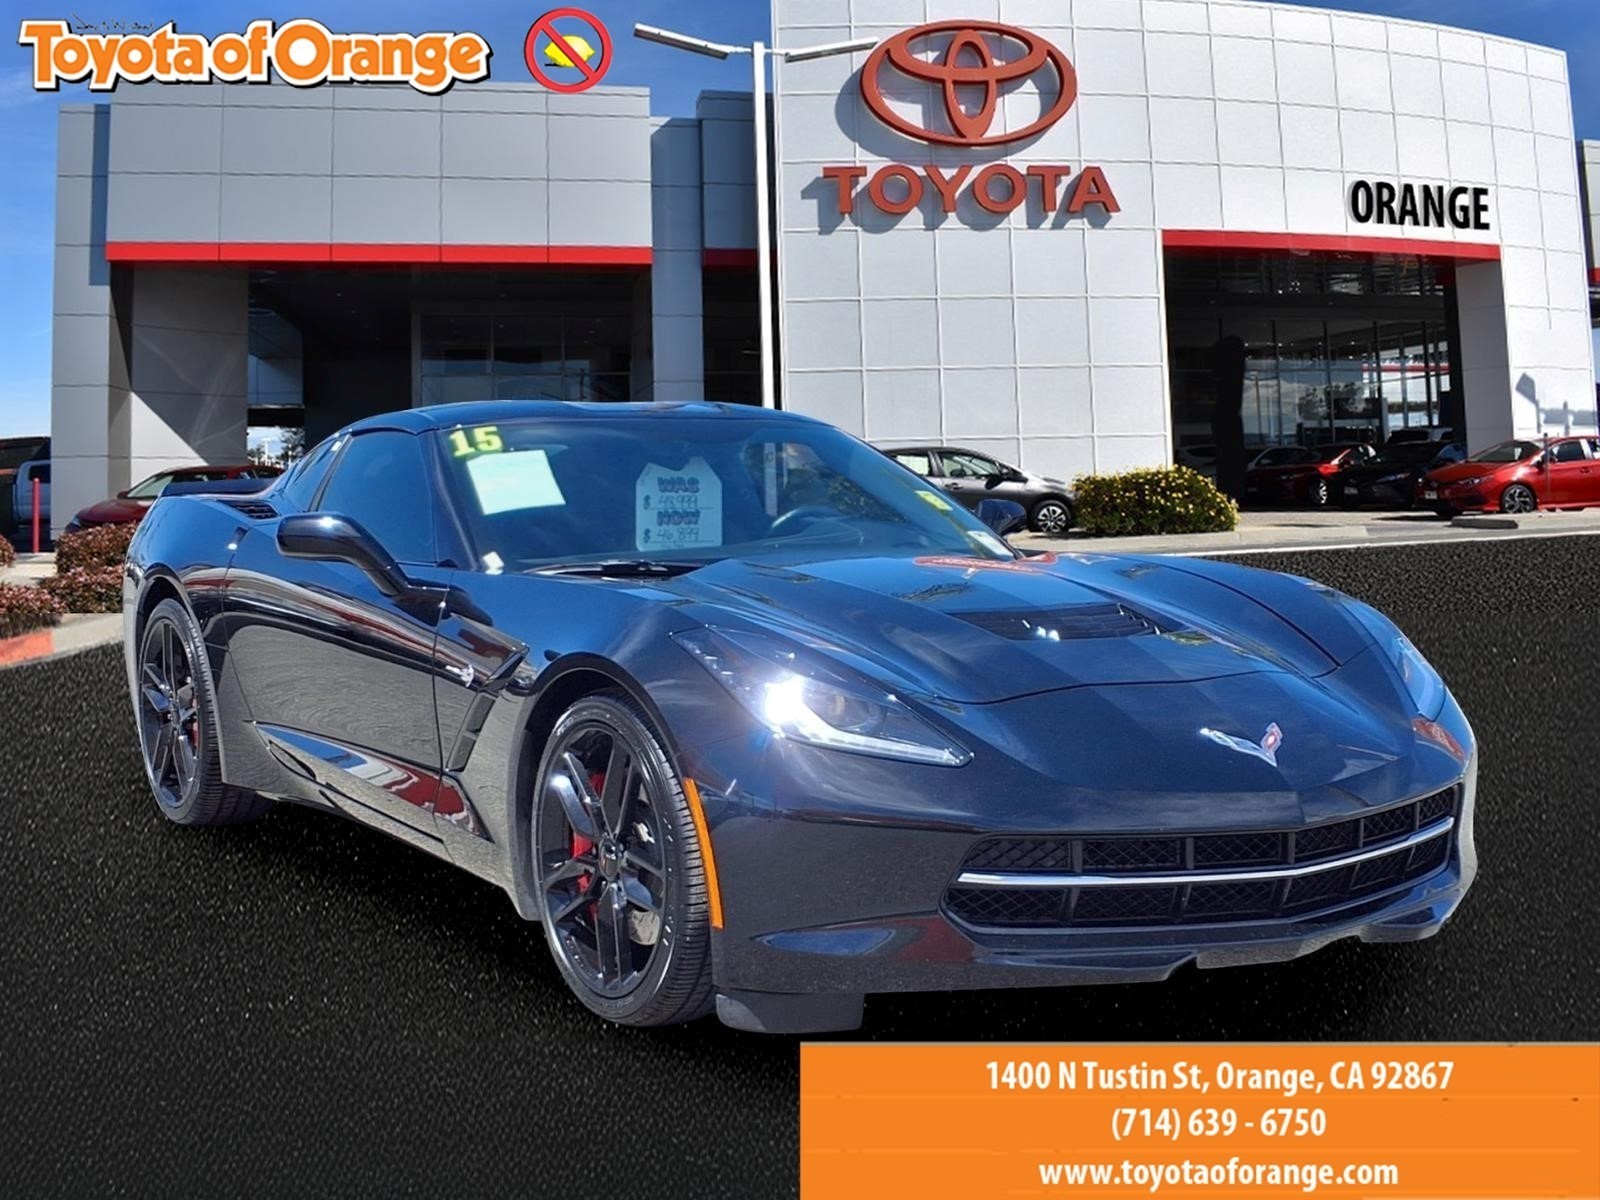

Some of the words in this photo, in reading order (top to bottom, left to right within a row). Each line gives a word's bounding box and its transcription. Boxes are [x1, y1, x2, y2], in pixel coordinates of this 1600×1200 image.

[822, 164, 1121, 214] TOYOTA
[1351, 180, 1490, 230] ORANGE
[450, 426, 504, 457] 15
[657, 476, 700, 493] WAS
[656, 511, 701, 526] NOW
